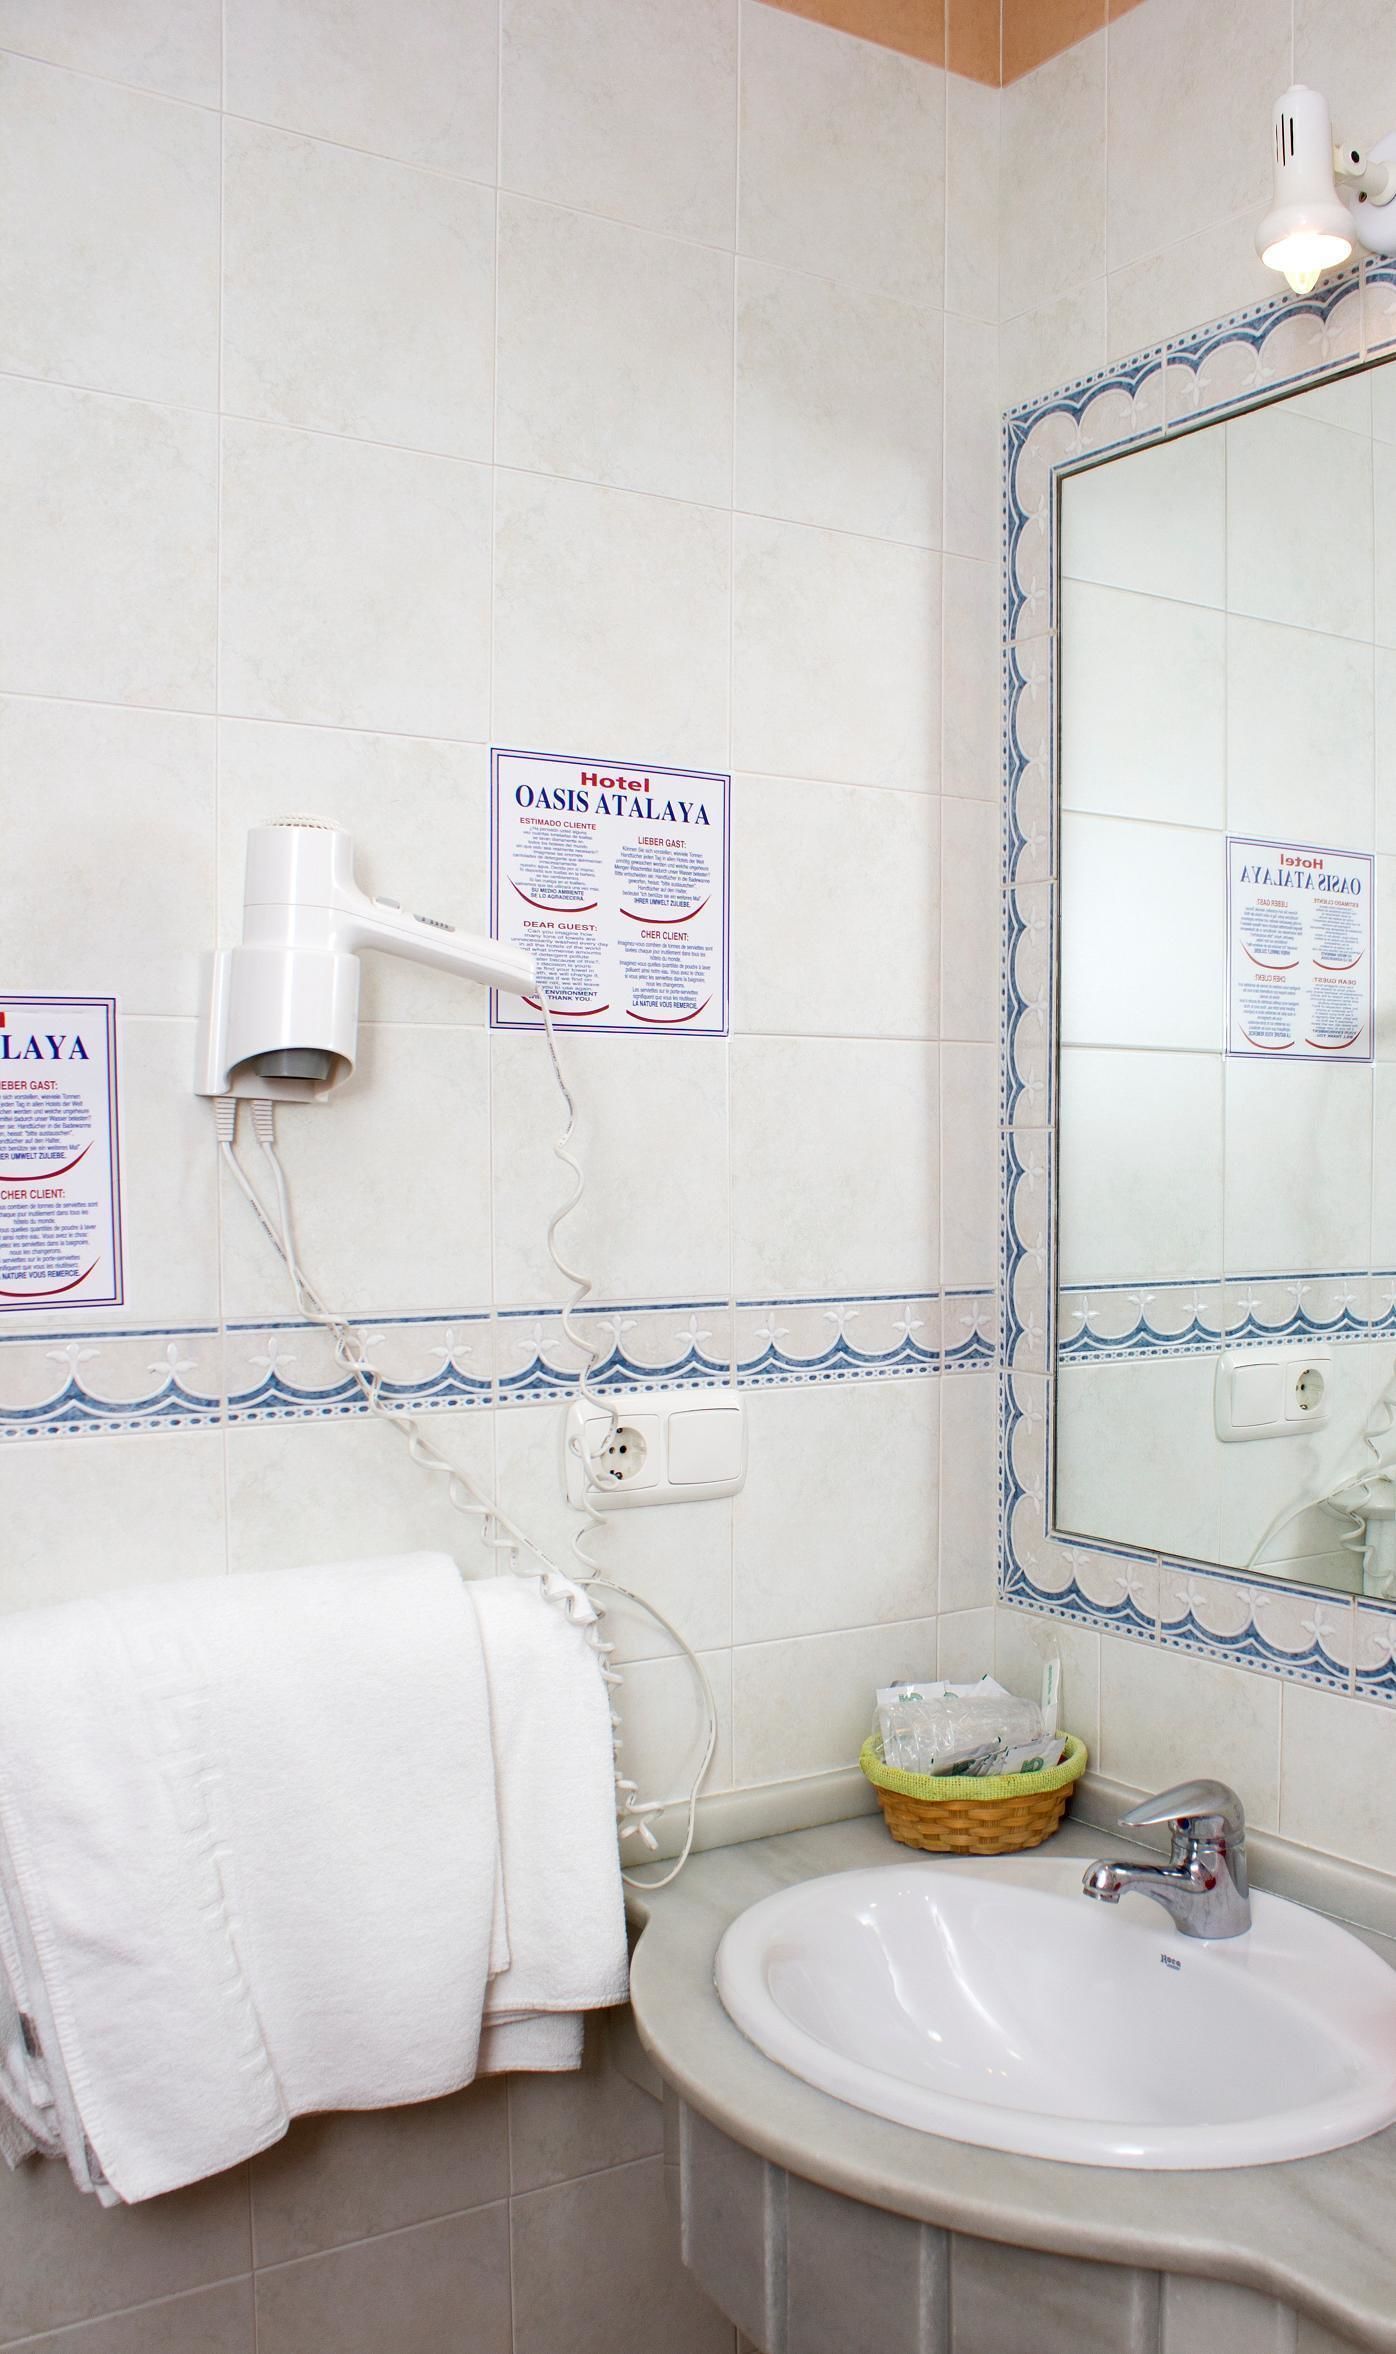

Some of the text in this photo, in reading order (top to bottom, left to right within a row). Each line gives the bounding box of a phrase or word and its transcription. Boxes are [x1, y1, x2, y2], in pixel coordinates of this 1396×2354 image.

[581, 772, 650, 792] Hotel
[516, 785, 710, 825] OASIS ATALAYA
[520, 817, 596, 830] ESTIMADO CLIENTE
[638, 836, 686, 848] LIEBER GAST:
[558, 923, 597, 931] GUEST:
[641, 930, 688, 941] CHER CLIENT:
[0, 1035, 89, 1060] LAYA
[0, 1081, 58, 1090] EBER GAST:
[1, 1189, 65, 1199] CHER CLIENT:
